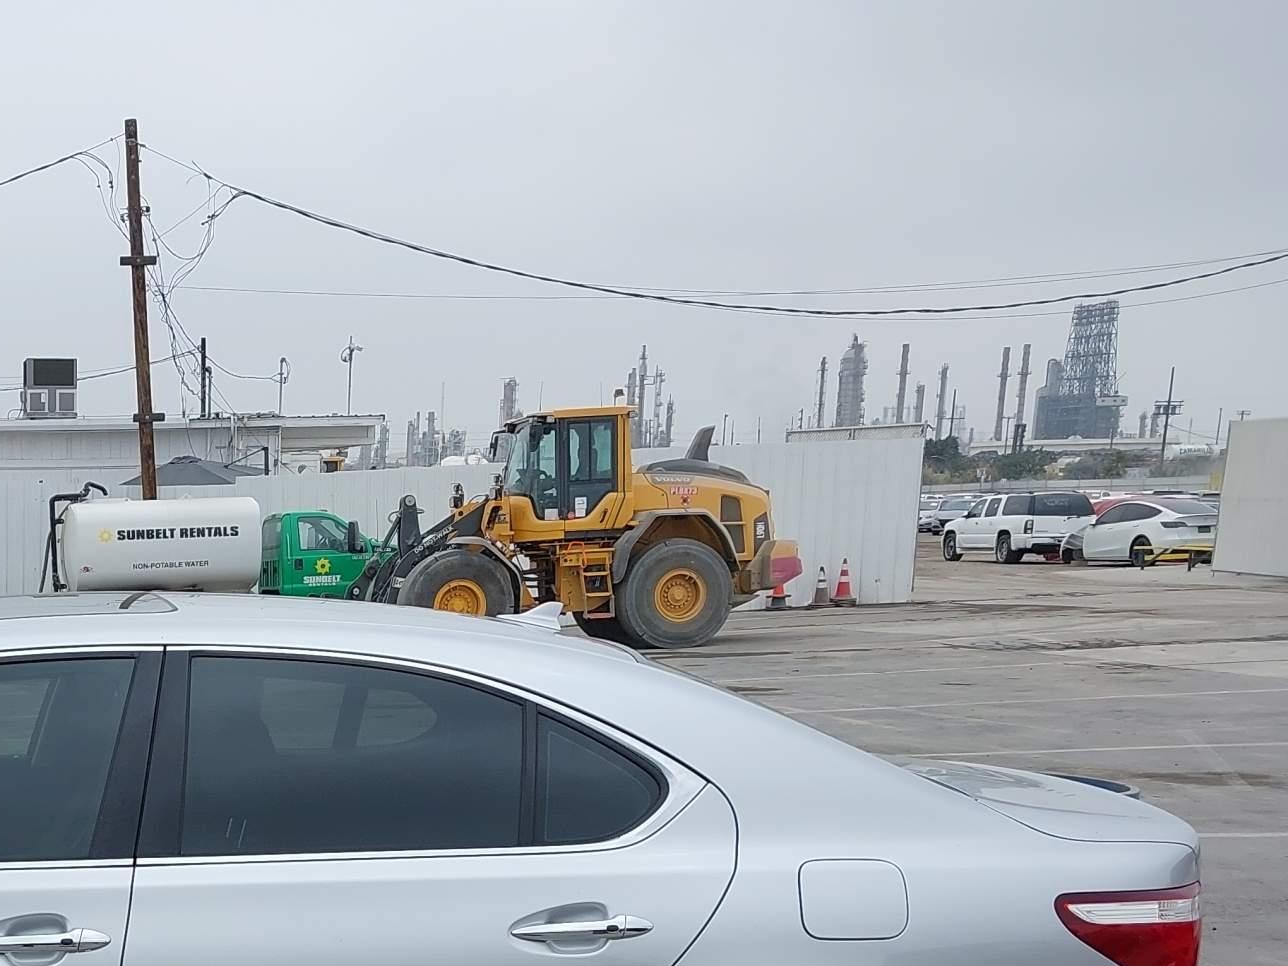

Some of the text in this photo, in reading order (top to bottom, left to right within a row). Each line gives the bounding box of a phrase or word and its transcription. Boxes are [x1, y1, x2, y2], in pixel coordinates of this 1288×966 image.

[116, 525, 240, 541] SUNBELT RENTALS
[132, 560, 209, 570] NON-POTABLE WATER
